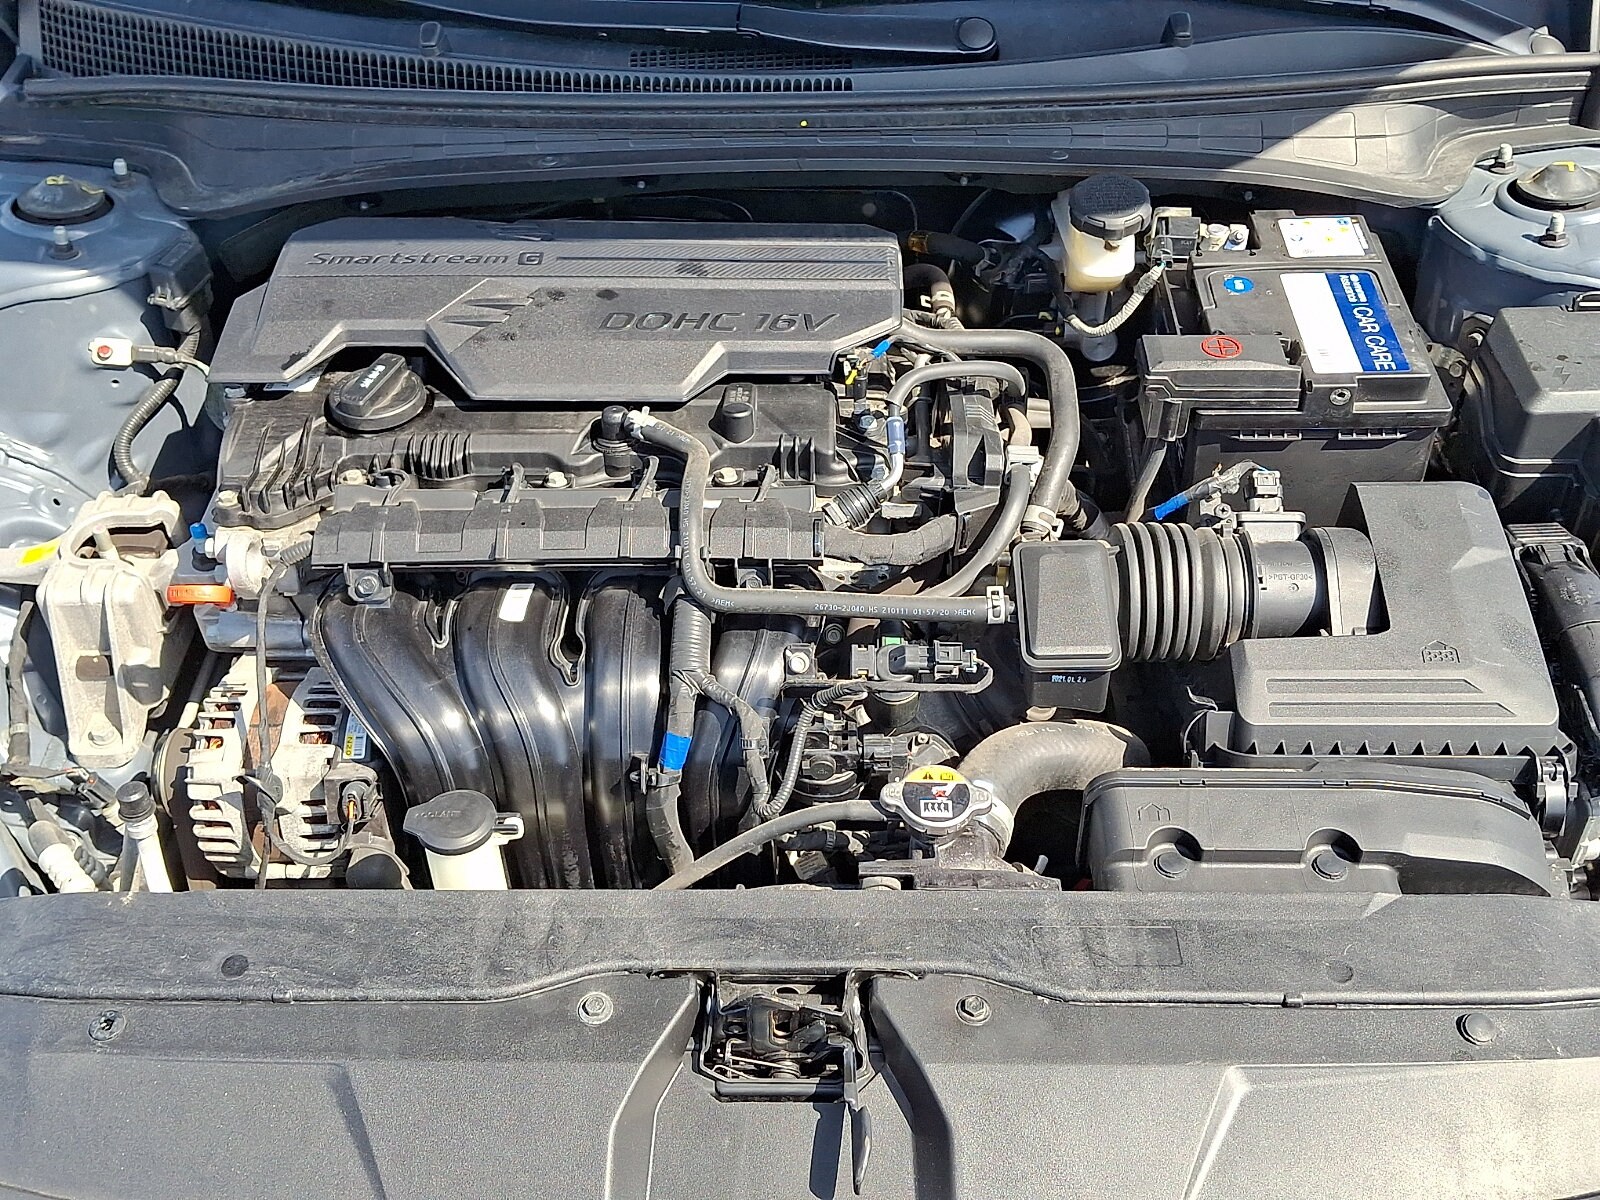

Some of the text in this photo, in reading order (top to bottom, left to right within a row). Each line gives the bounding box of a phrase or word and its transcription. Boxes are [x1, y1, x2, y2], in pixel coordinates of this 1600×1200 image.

[306, 252, 509, 265] Smartstream
[599, 312, 840, 332] DOHC 16V
[1352, 306, 1381, 334] CAR
[1364, 335, 1397, 371] CARE
[868, 606, 879, 614] HS
